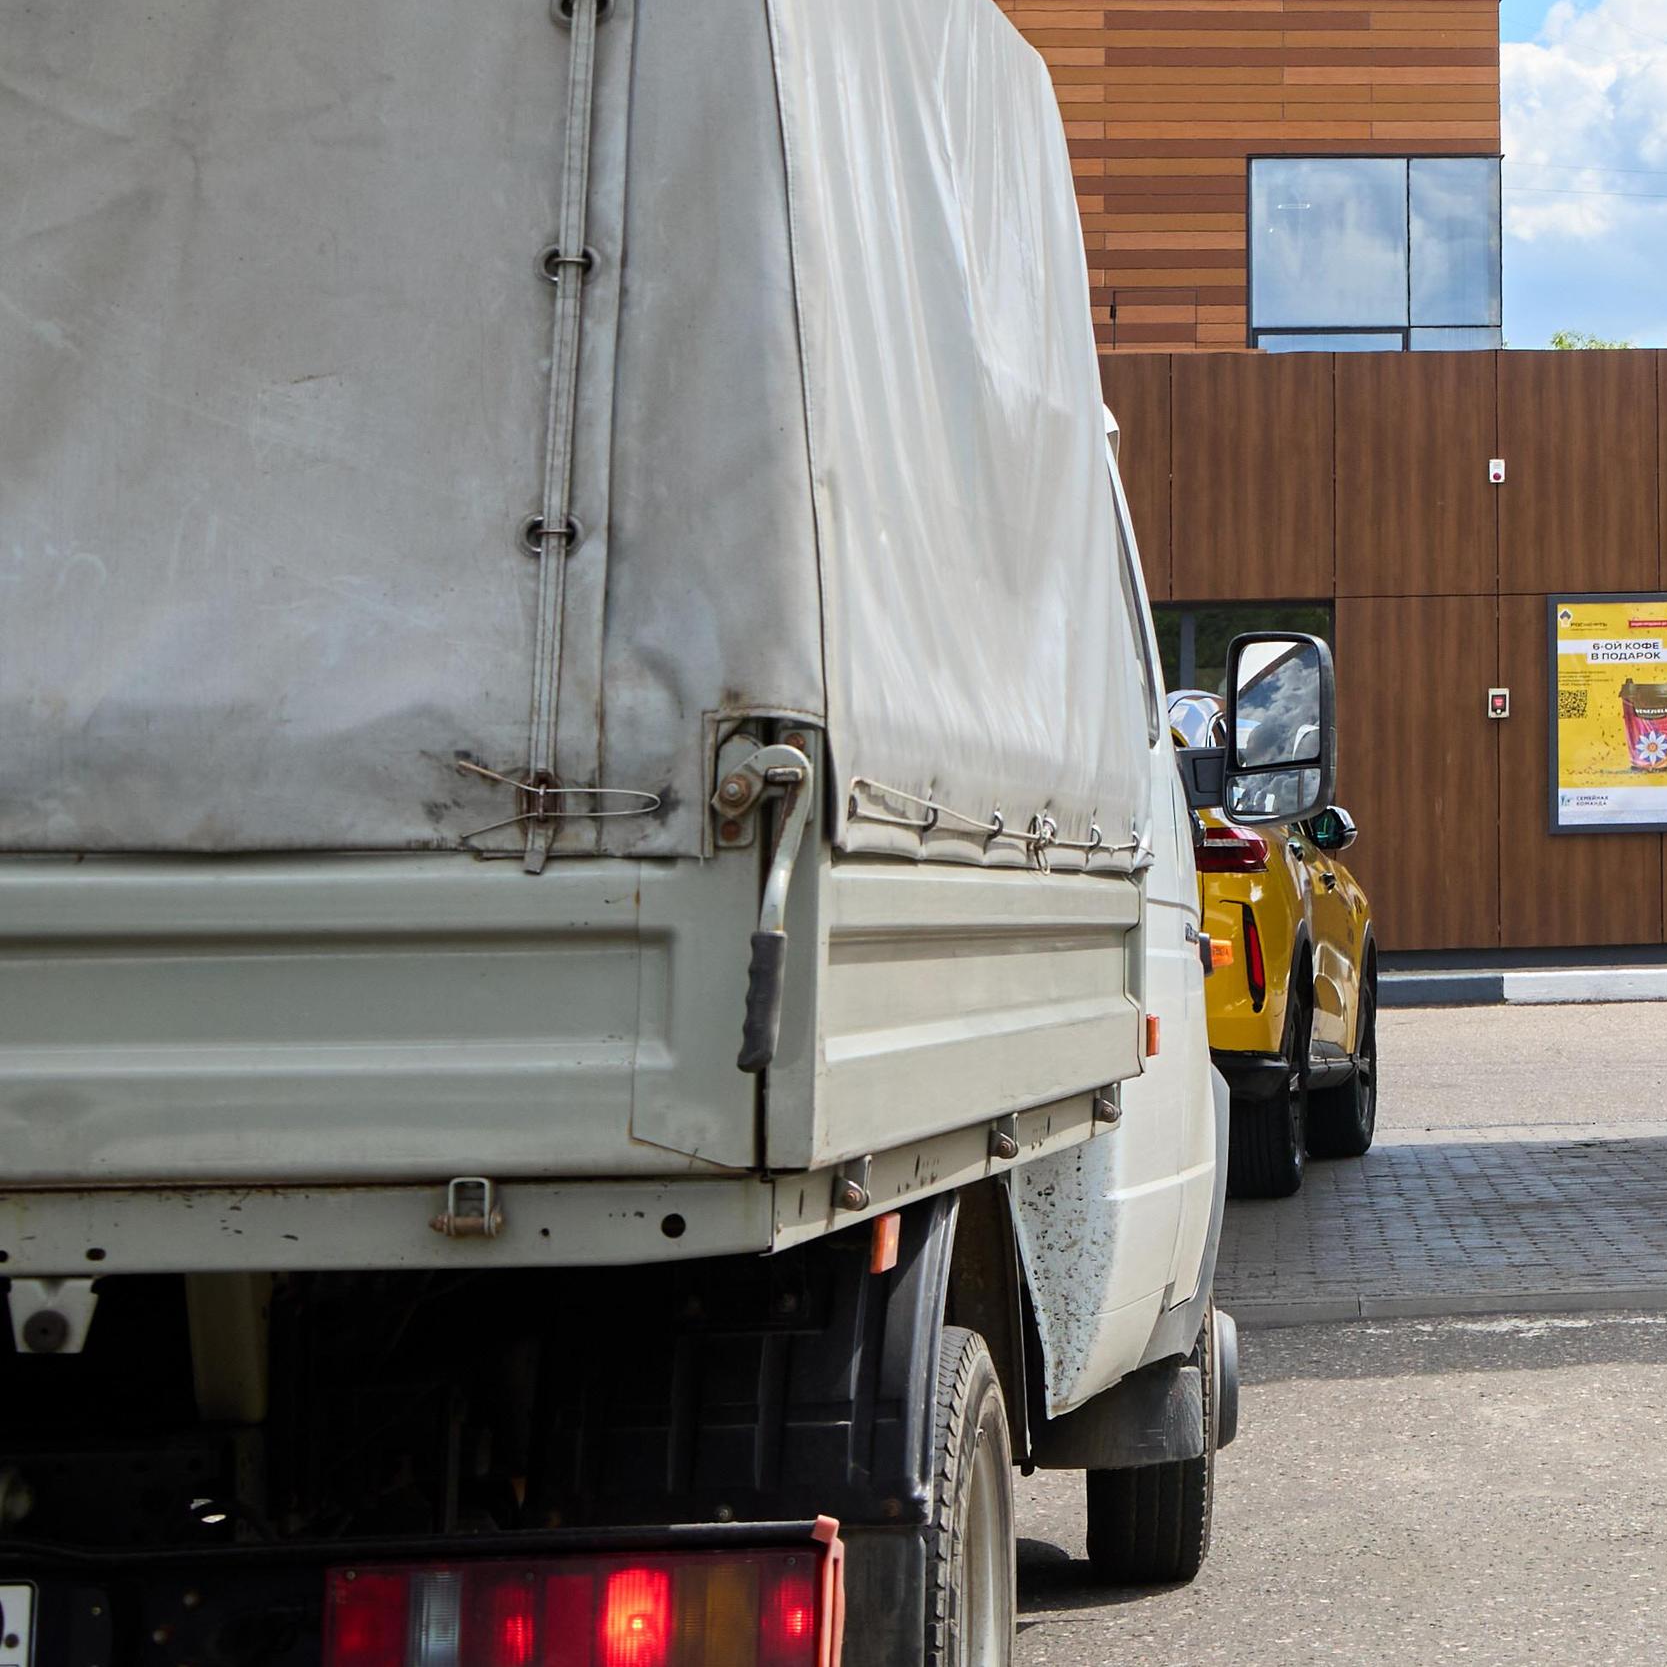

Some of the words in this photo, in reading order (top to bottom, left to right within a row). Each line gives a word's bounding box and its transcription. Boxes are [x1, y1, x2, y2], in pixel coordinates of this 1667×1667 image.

[1592, 641, 1622, 650] 6-ОЙ
[1625, 642, 1659, 650] КОФЕ
[1602, 652, 1660, 661] ПОДАРОК
